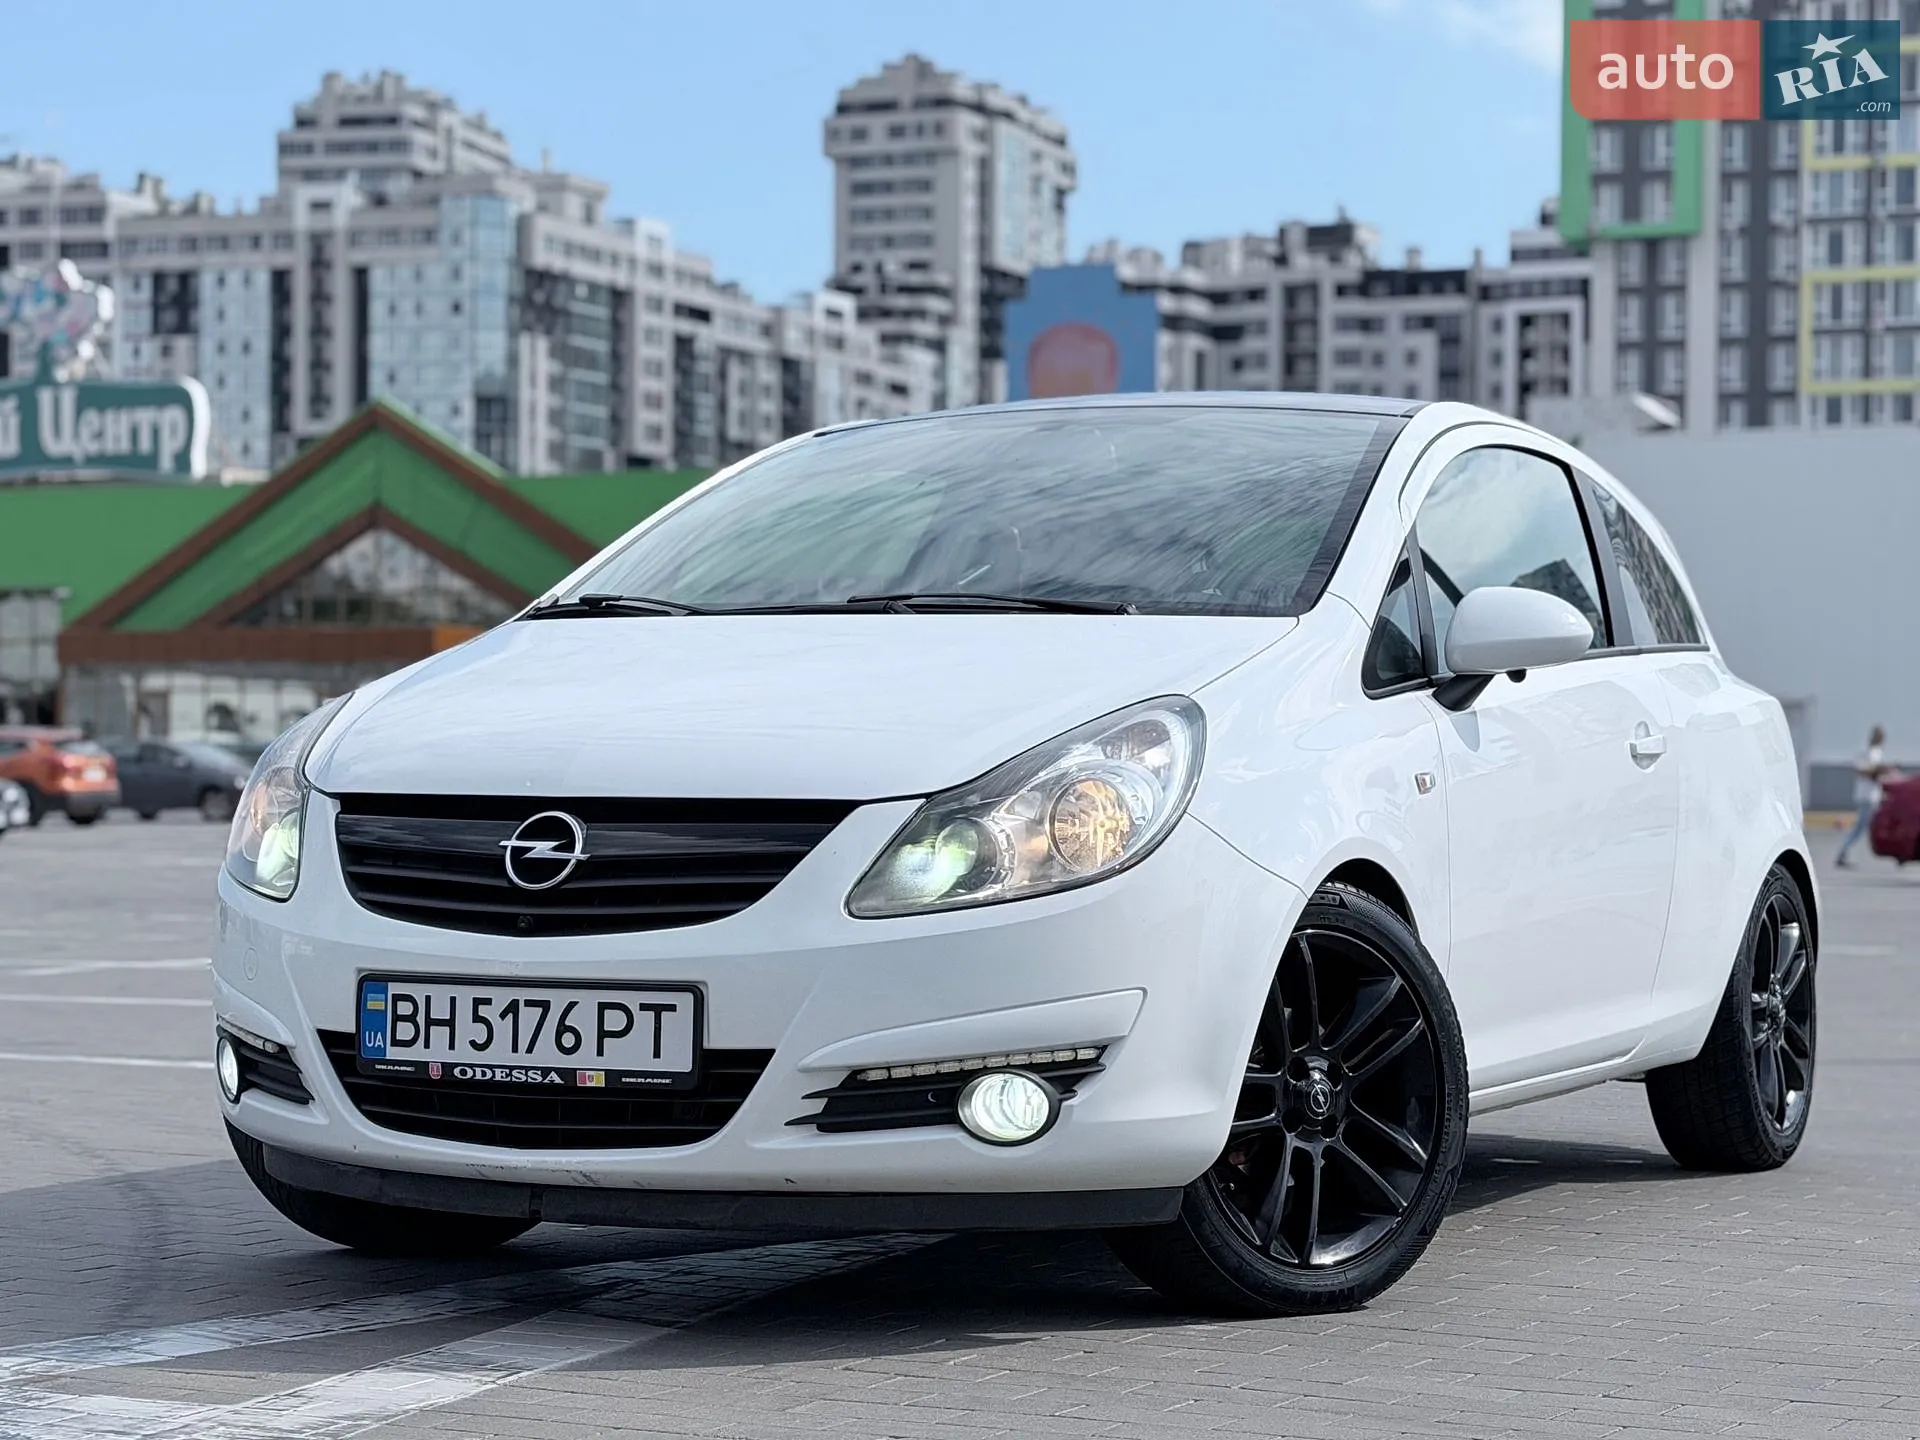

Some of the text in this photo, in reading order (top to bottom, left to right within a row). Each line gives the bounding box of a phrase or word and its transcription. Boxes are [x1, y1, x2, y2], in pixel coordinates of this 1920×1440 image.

[36, 384, 189, 474] Центр
[365, 1031, 385, 1048] UA
[390, 993, 678, 1059] BH 5176 PT
[453, 1066, 564, 1084] ODESSA
